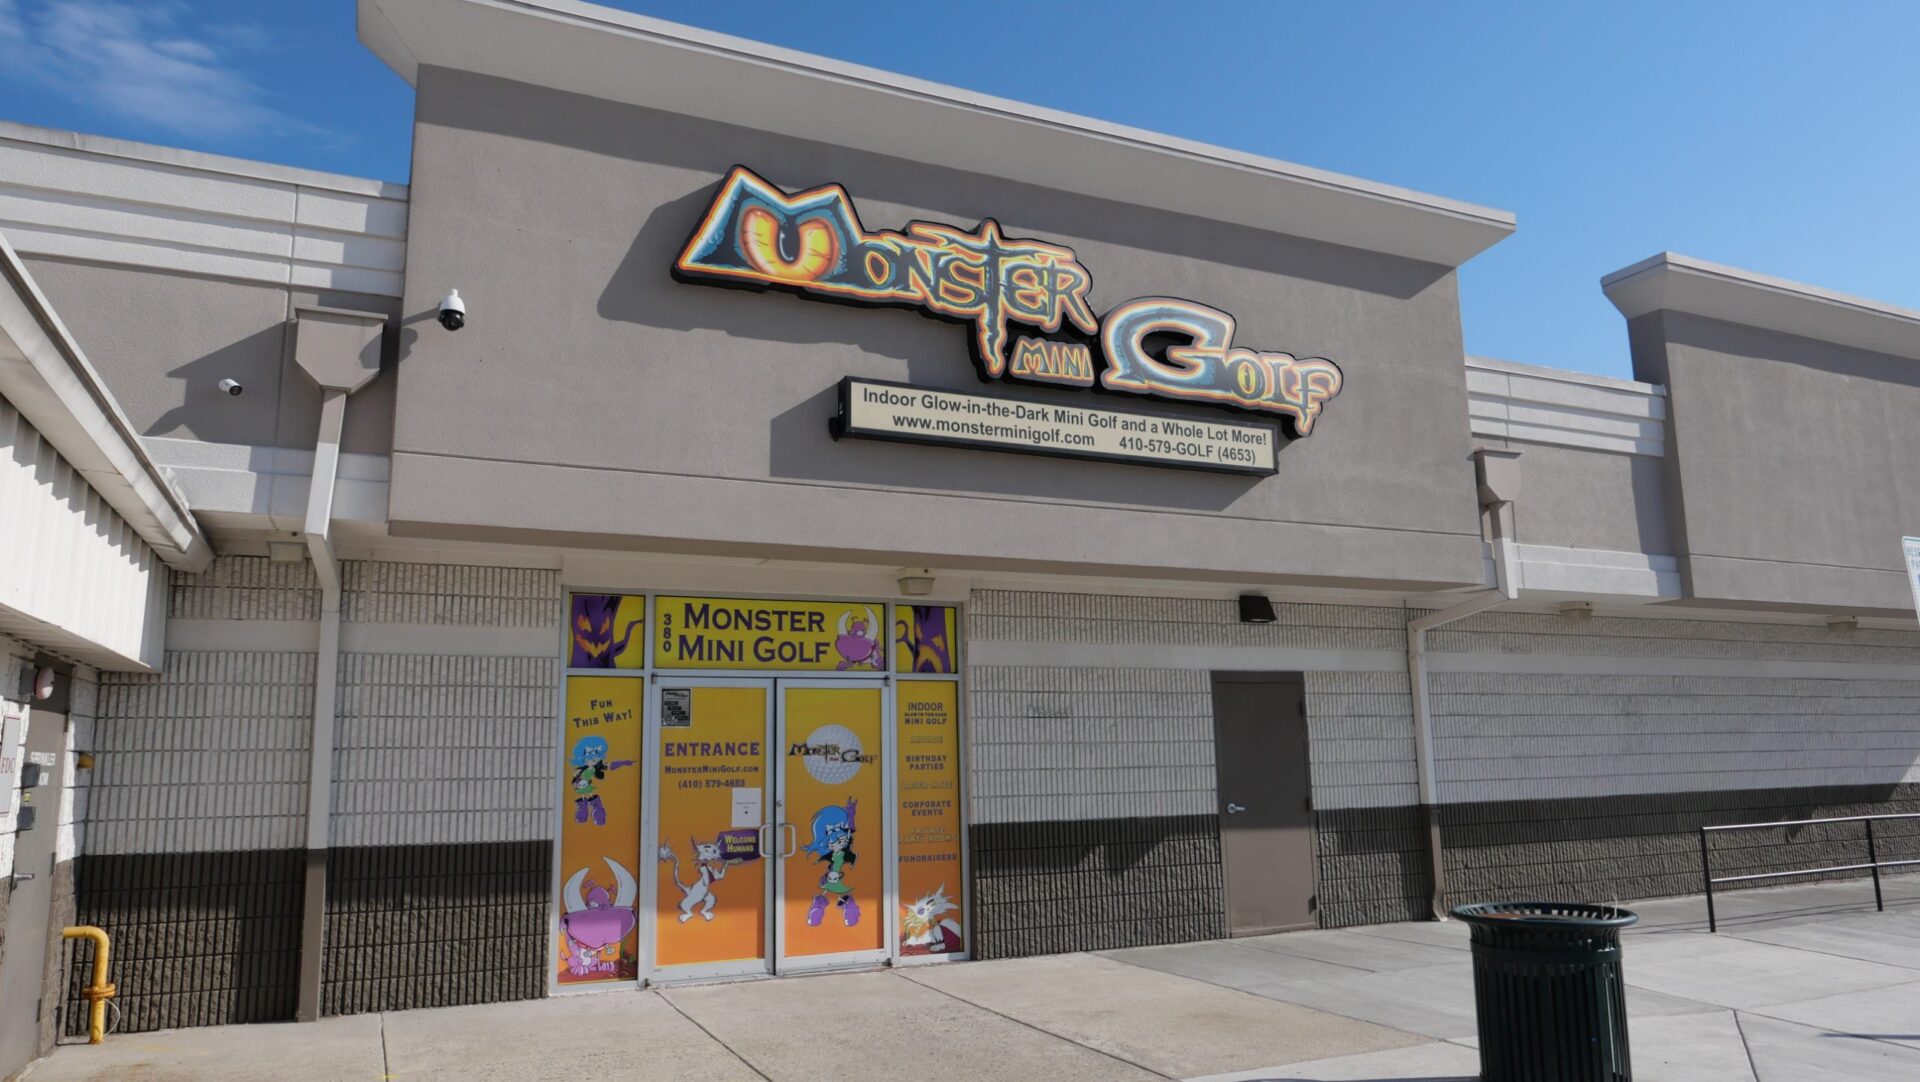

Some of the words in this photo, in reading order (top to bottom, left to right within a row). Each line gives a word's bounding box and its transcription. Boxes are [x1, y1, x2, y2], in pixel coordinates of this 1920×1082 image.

[1011, 339, 1094, 381] MINI
[1102, 297, 1342, 434] GOLF
[863, 387, 917, 407] Indoor
[921, 394, 1050, 422] Glow-in-the-Dark
[1054, 409, 1084, 426] Mini
[1088, 413, 1118, 430] Golf
[1121, 418, 1147, 433] and
[1150, 422, 1158, 434] a
[1162, 421, 1204, 439] Whole
[1207, 426, 1229, 442] Lot
[1231, 429, 1266, 446] More!
[892, 414, 1095, 446] www.monsterminigolf.com
[1119, 436, 1213, 459] 410-579-GOLF
[1217, 446, 1256, 465] (4653)
[684, 602, 825, 633] MONSTER
[678, 634, 744, 662] MINI
[753, 636, 831, 664] GOLF
[908, 702, 944, 711] INDOOR
[664, 742, 760, 757] ENTRANCE
[905, 754, 948, 762] BIRTHDAY
[910, 763, 944, 771] PARTIES
[678, 780, 703, 790] (410)
[705, 779, 746, 788] 579-4653
[902, 800, 952, 809] CORPORATE
[898, 853, 957, 863] FUNDRAISERS
